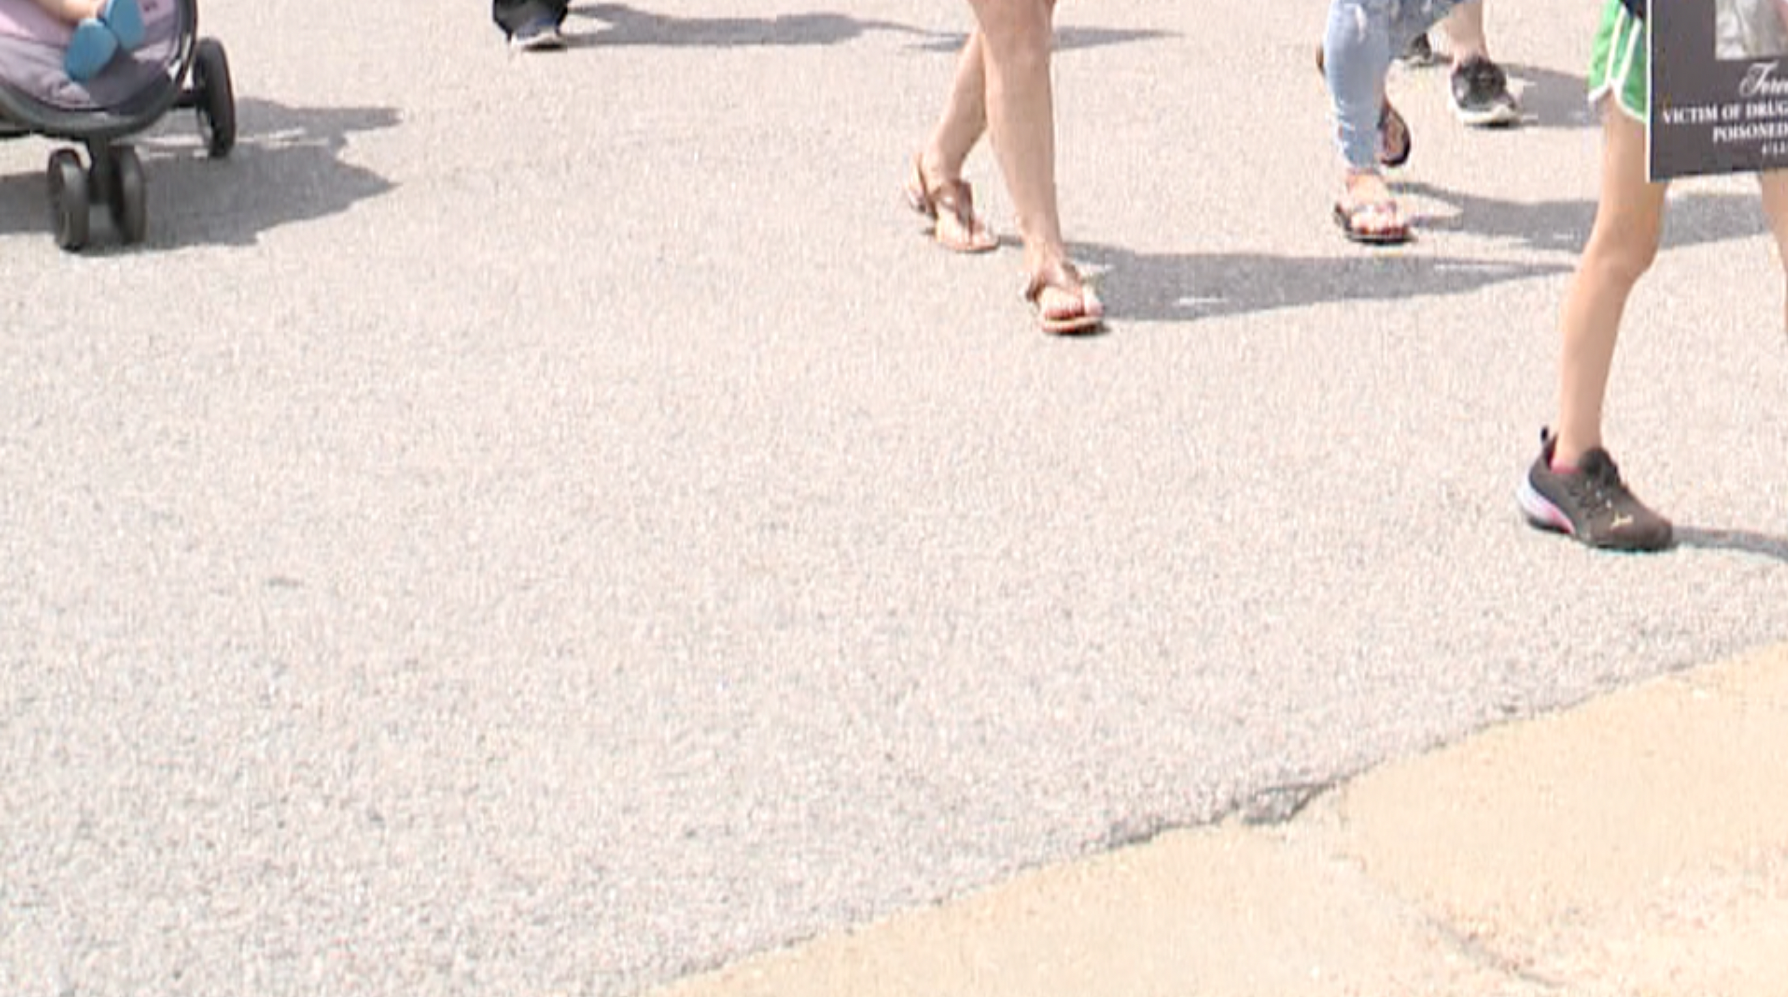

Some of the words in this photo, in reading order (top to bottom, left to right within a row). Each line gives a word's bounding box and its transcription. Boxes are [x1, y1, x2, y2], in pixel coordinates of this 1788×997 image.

[1661, 104, 1719, 125] VICTIM
[1721, 103, 1740, 120] OF
[1712, 121, 1788, 143] POISONED
